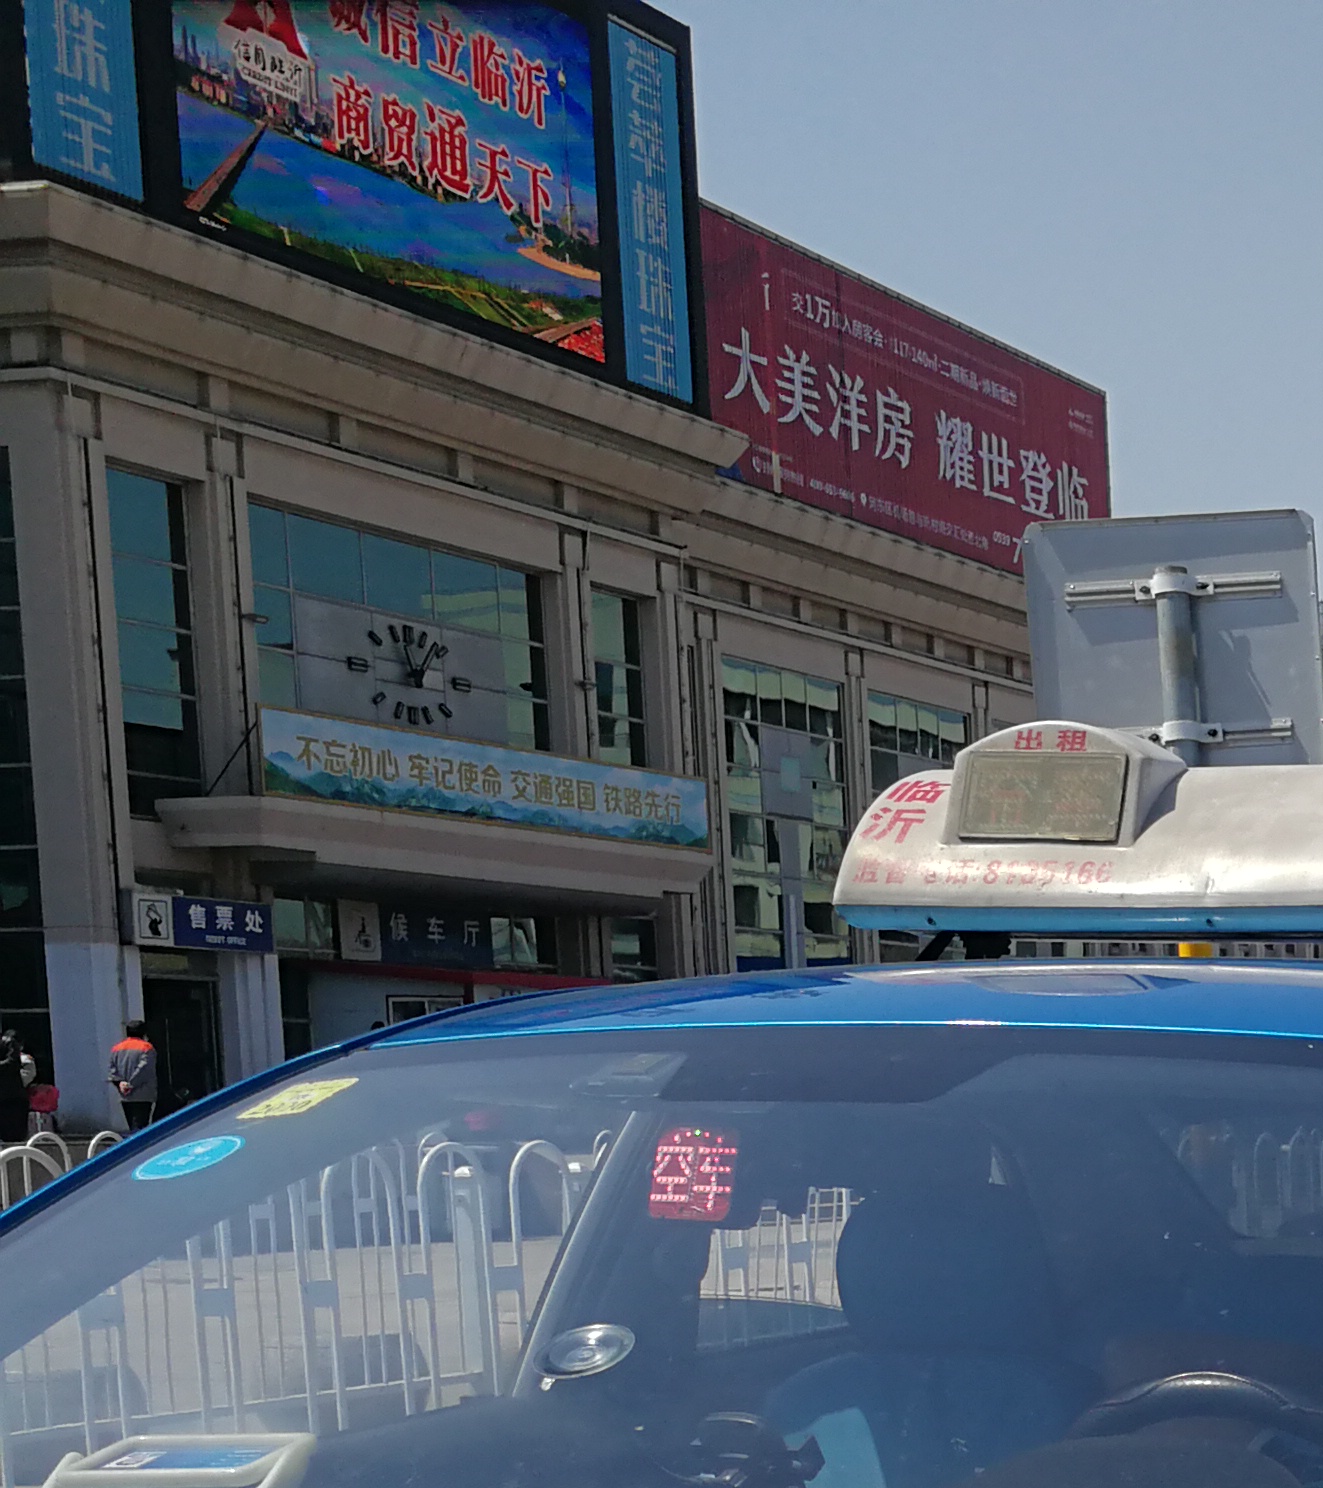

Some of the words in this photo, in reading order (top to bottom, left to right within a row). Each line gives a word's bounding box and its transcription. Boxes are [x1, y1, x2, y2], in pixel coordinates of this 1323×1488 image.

[331, 75, 554, 228] 商贸通天下
[722, 327, 914, 469] 大美洋房
[935, 408, 1090, 521] 耀世登临
[1014, 729, 1087, 752] 出租
[295, 734, 400, 783] 不忘初心
[407, 751, 502, 799] 牢记使命
[510, 769, 597, 812] 交通强国
[603, 783, 682, 826] 铁路先行
[860, 779, 952, 844] 临沂
[187, 903, 265, 934] 售票处
[388, 911, 481, 948] 候车厅
[648, 1145, 738, 1211] 空车
